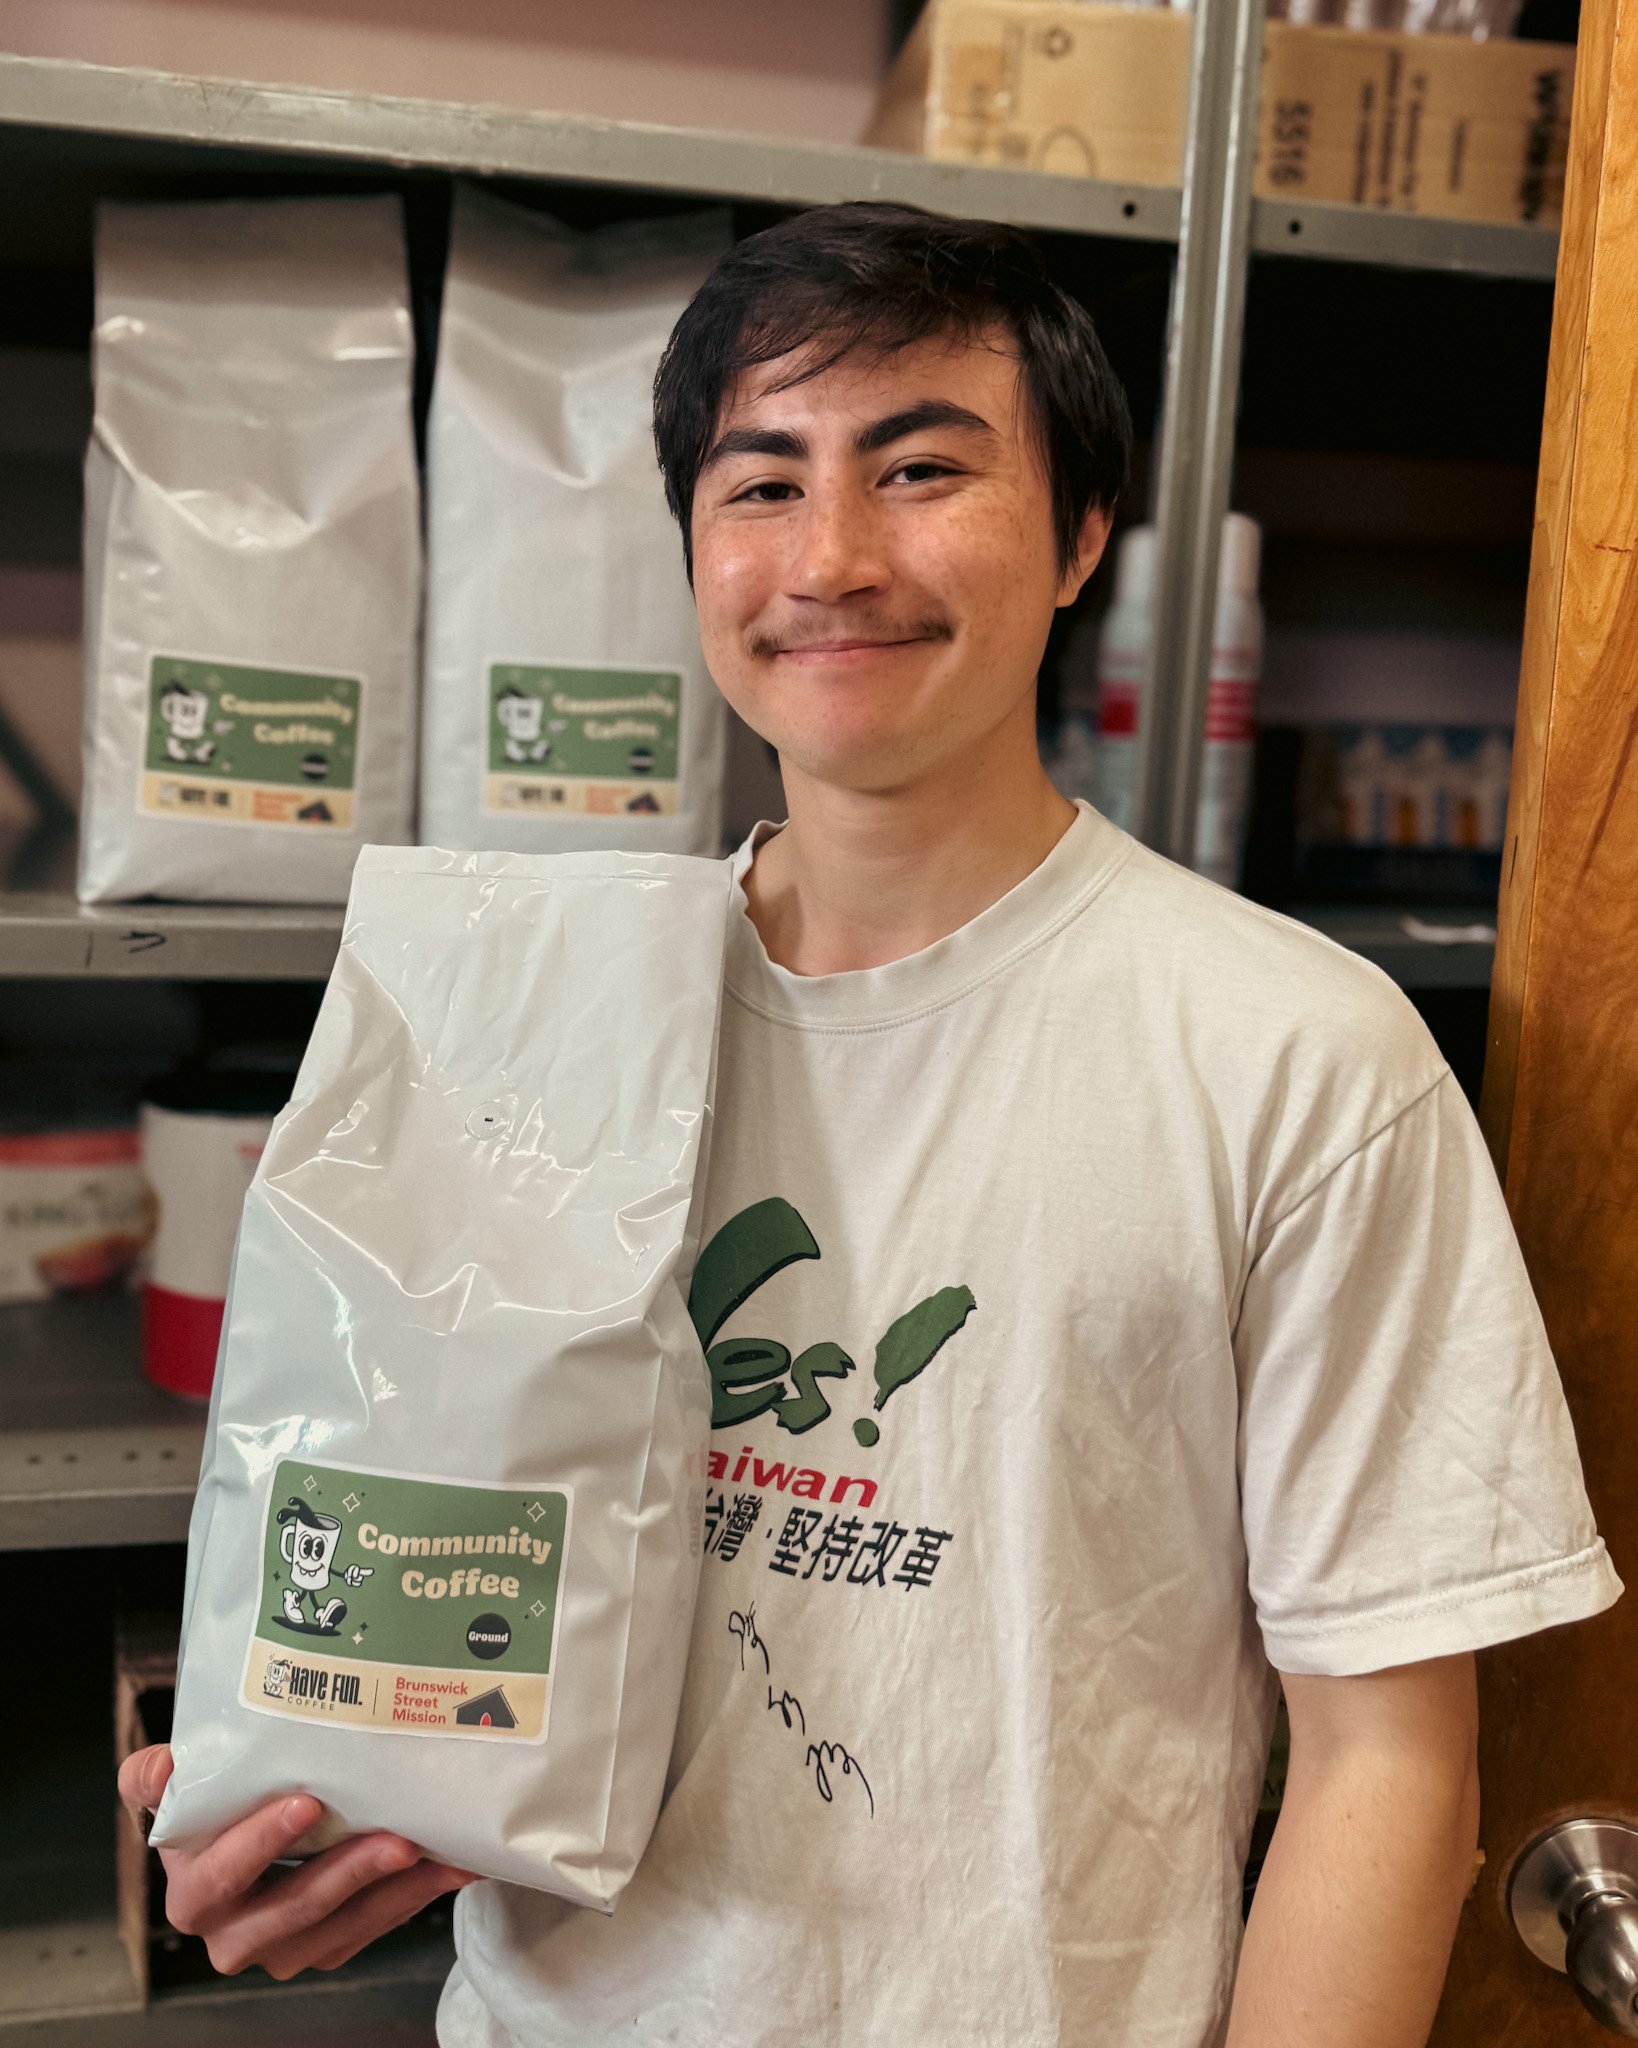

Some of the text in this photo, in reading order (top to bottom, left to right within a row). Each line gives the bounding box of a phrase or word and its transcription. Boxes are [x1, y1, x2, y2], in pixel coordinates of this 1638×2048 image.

[707, 1446, 879, 1508] aiwan
[357, 1522, 553, 1565] Community
[401, 1567, 520, 1600] Coffee
[468, 1630, 509, 1644] Ground
[395, 1676, 469, 1696] Brunswick
[287, 1696, 335, 1712] COFFEE
[393, 1692, 439, 1709] Street
[392, 1707, 447, 1725] Mission
